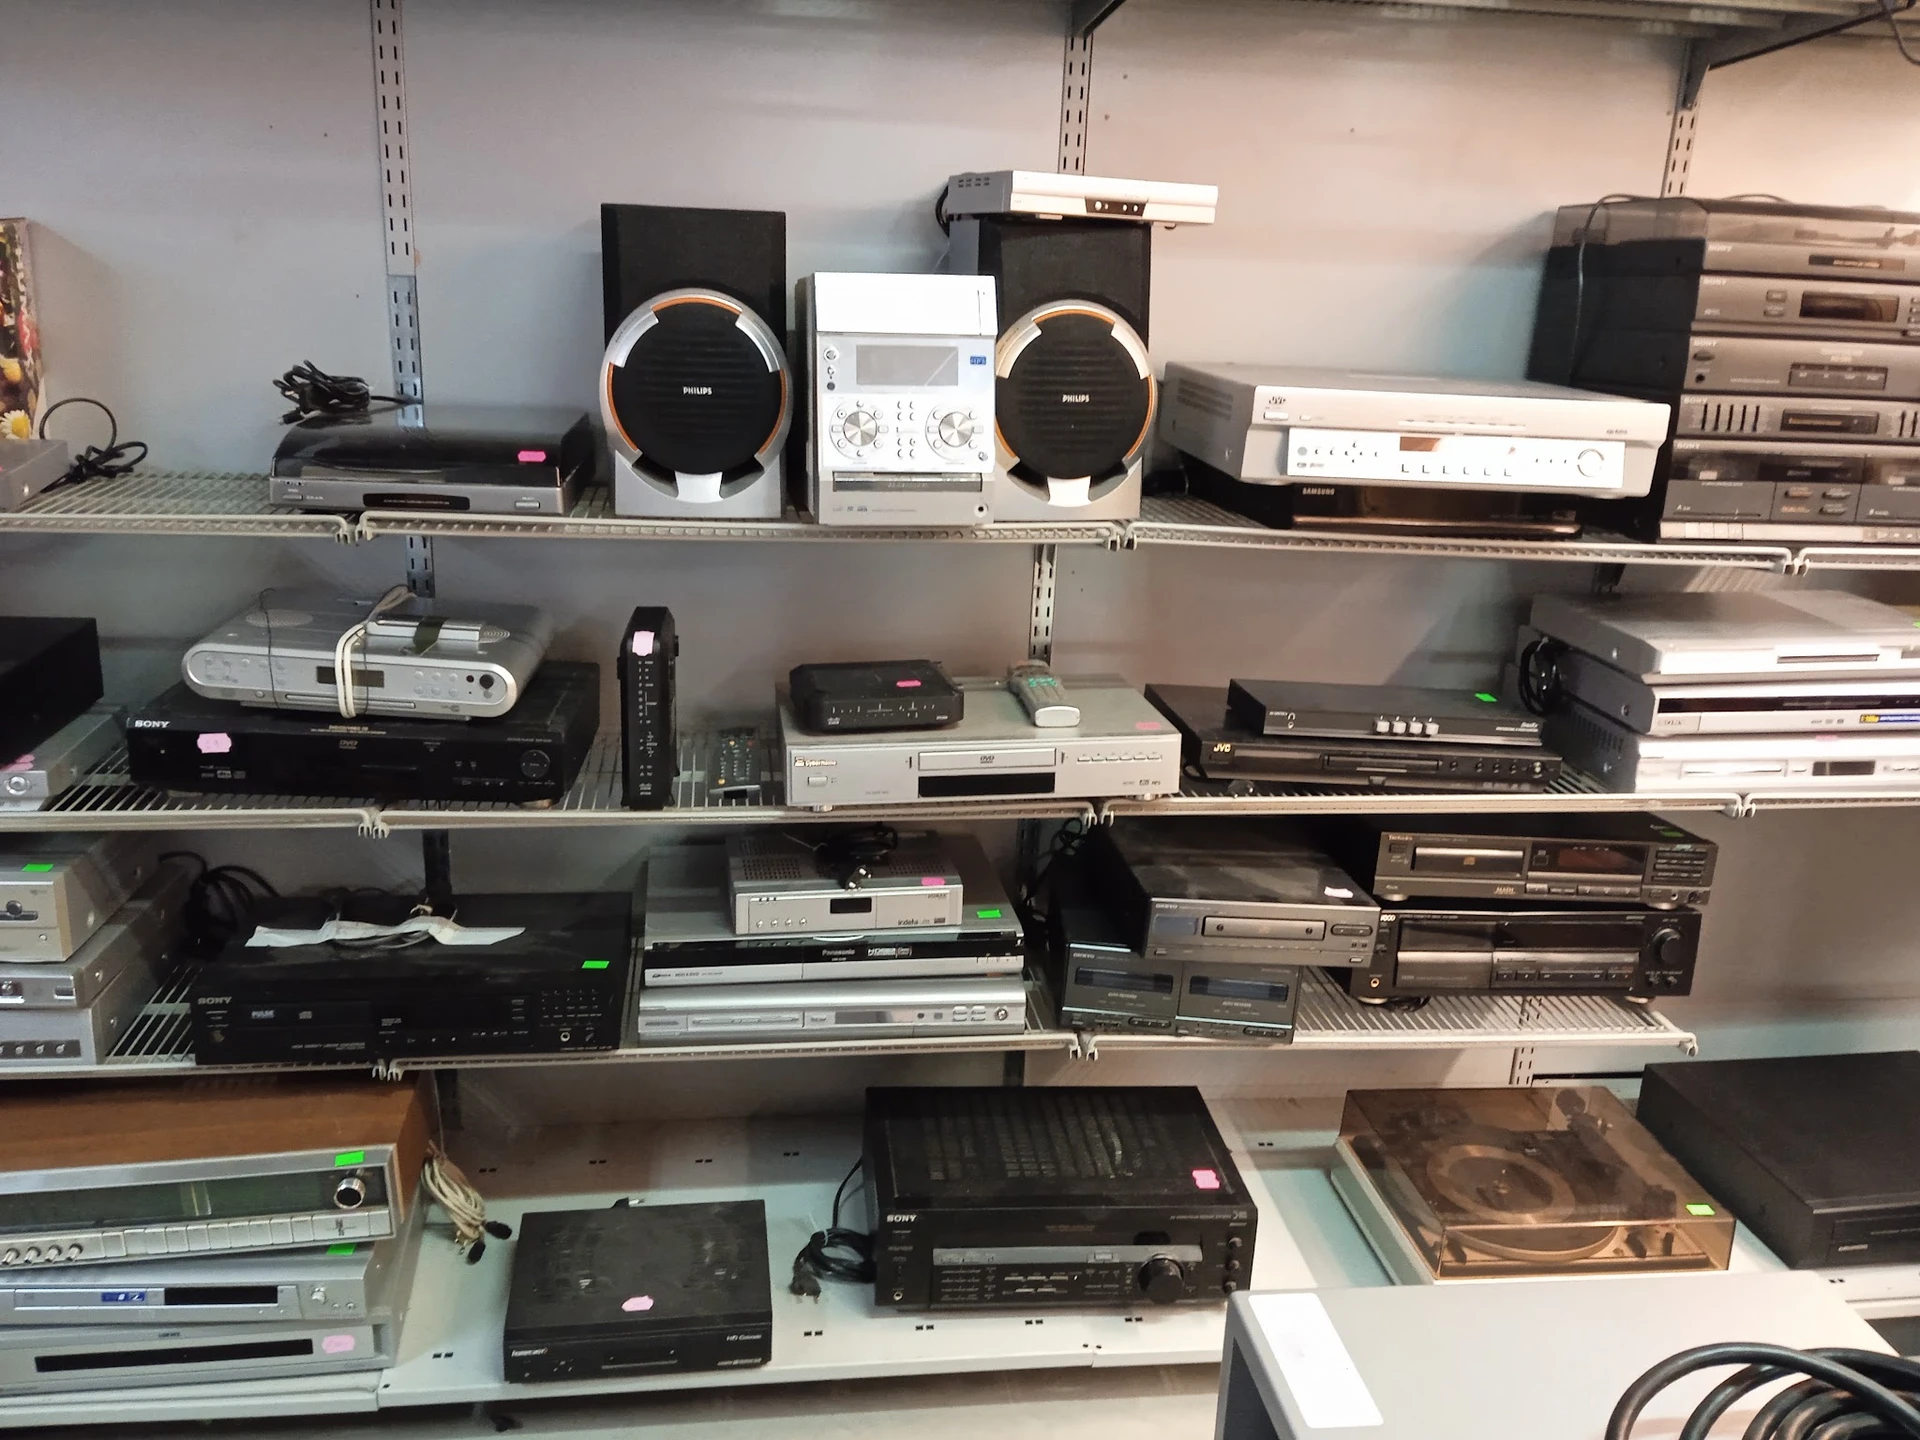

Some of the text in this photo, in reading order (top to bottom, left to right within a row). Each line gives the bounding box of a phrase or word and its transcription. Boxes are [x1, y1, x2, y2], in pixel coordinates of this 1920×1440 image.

[683, 386, 713, 396] PHILIPS
[1062, 394, 1090, 403] PHILIPS
[1677, 442, 1701, 450] SONY
[1302, 487, 1335, 496] SAMSUNG
[134, 719, 170, 729] SONY
[1213, 743, 1232, 753] JVC
[822, 949, 856, 957] Panasonic
[197, 996, 233, 1006] SONY
[886, 1214, 918, 1223] SONY
